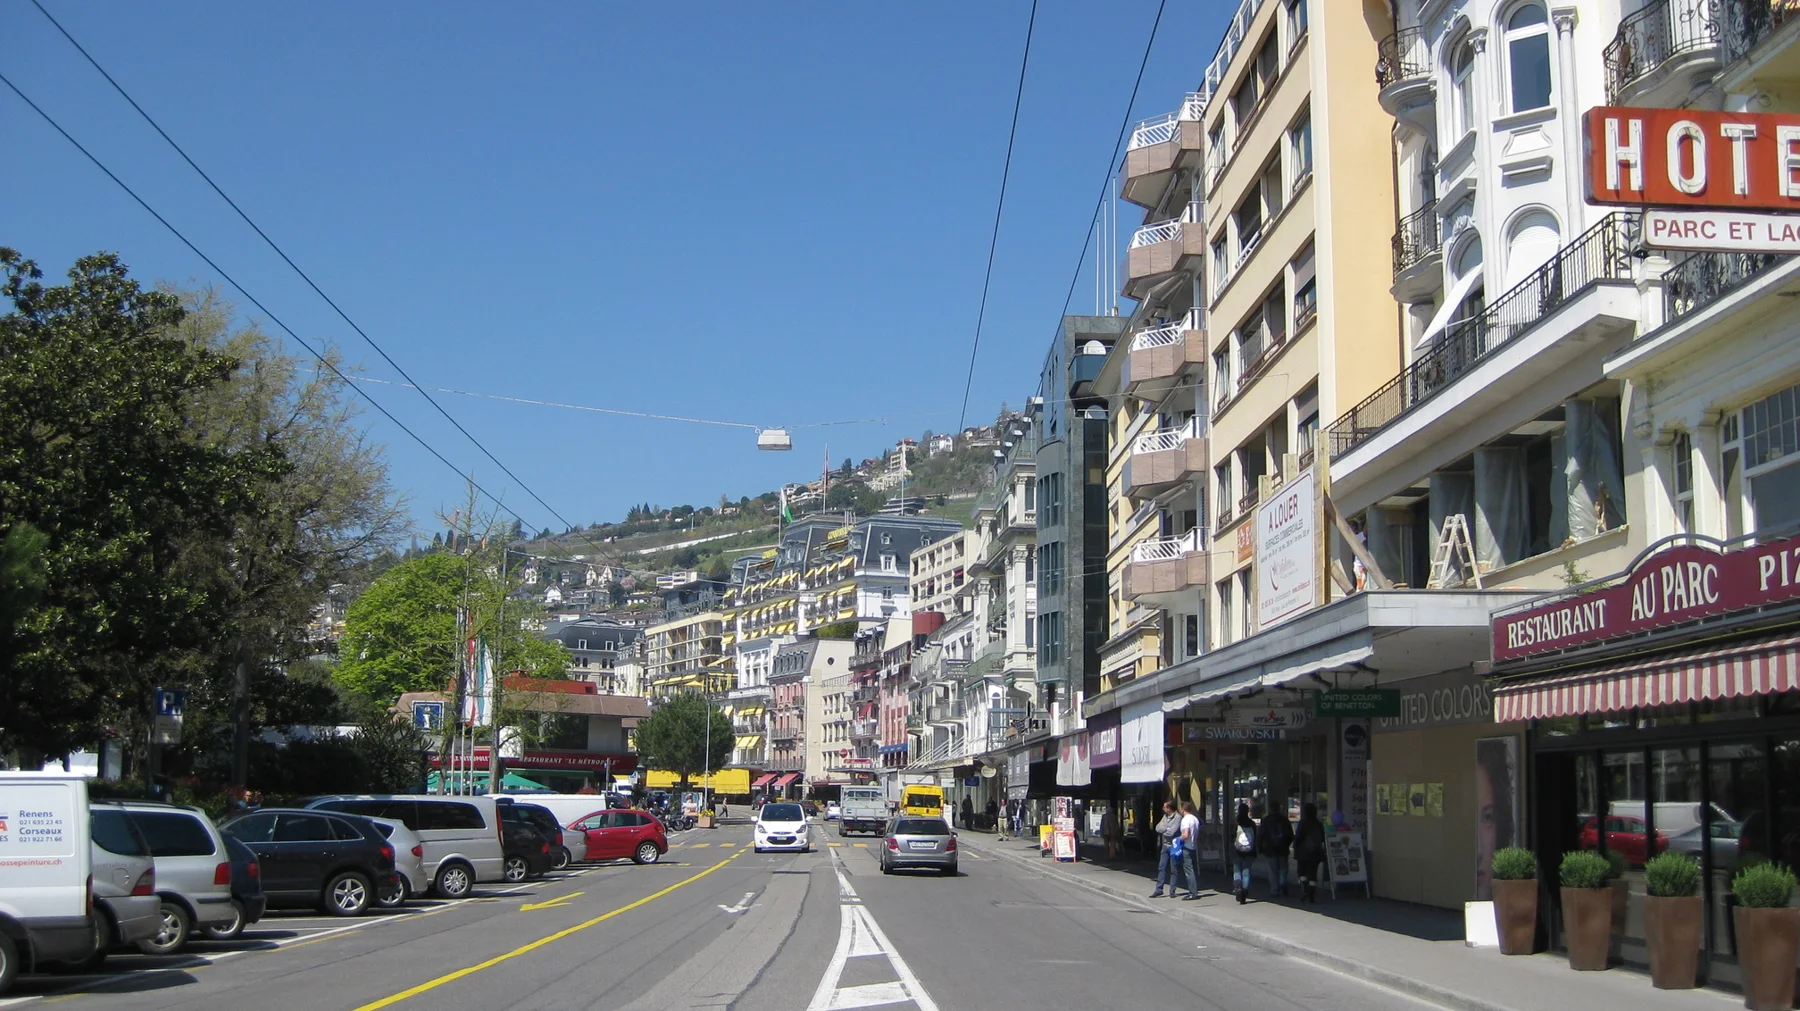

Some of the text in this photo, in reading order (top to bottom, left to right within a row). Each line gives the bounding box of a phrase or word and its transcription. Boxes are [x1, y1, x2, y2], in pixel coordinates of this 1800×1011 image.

[1653, 219, 1717, 239] PARC
[1729, 222, 1756, 240] ET
[1268, 493, 1299, 533] A LOUER
[1508, 598, 1606, 649] RESTAURANT
[1631, 572, 1656, 621] AU
[1661, 561, 1719, 613] PARC
[1432, 684, 1491, 721] COLORS
[1205, 727, 1275, 739] SWAROVSKI
[519, 756, 563, 764] RESTAURANT
[19, 810, 54, 818] Renens
[19, 827, 63, 835] Corseaux
[0, 858, 63, 867] ossepeinture.ch
